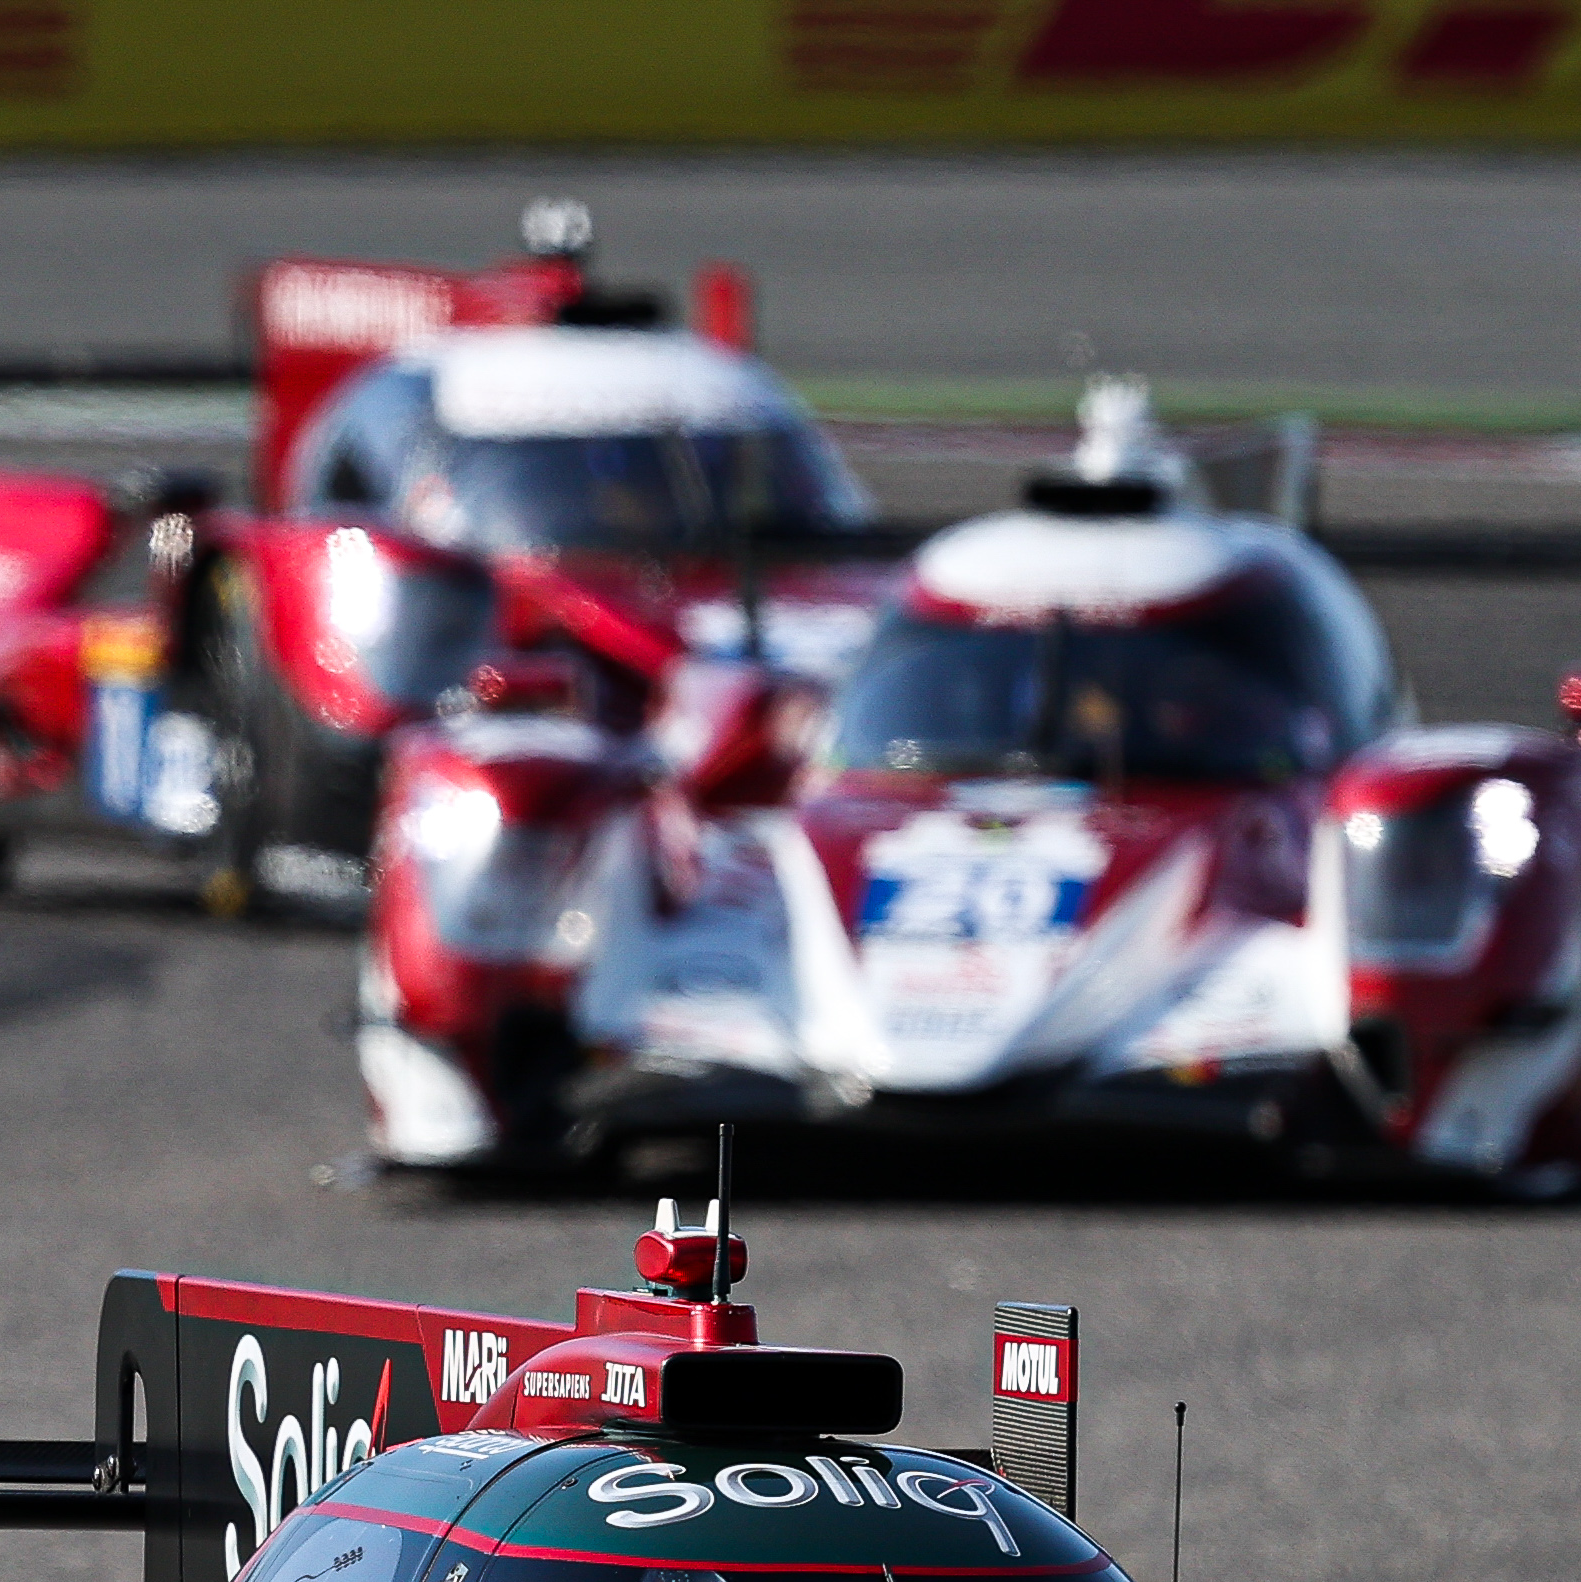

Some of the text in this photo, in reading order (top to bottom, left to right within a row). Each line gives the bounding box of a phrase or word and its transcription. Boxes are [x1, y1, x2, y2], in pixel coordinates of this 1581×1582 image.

[523, 1371, 591, 1399] SUPERSAPIENS
[601, 1361, 645, 1407] JOTA
[1001, 1342, 1058, 1394] MOTUL
[224, 1333, 376, 1582] Soli
[587, 1456, 1021, 1556] Soliq
